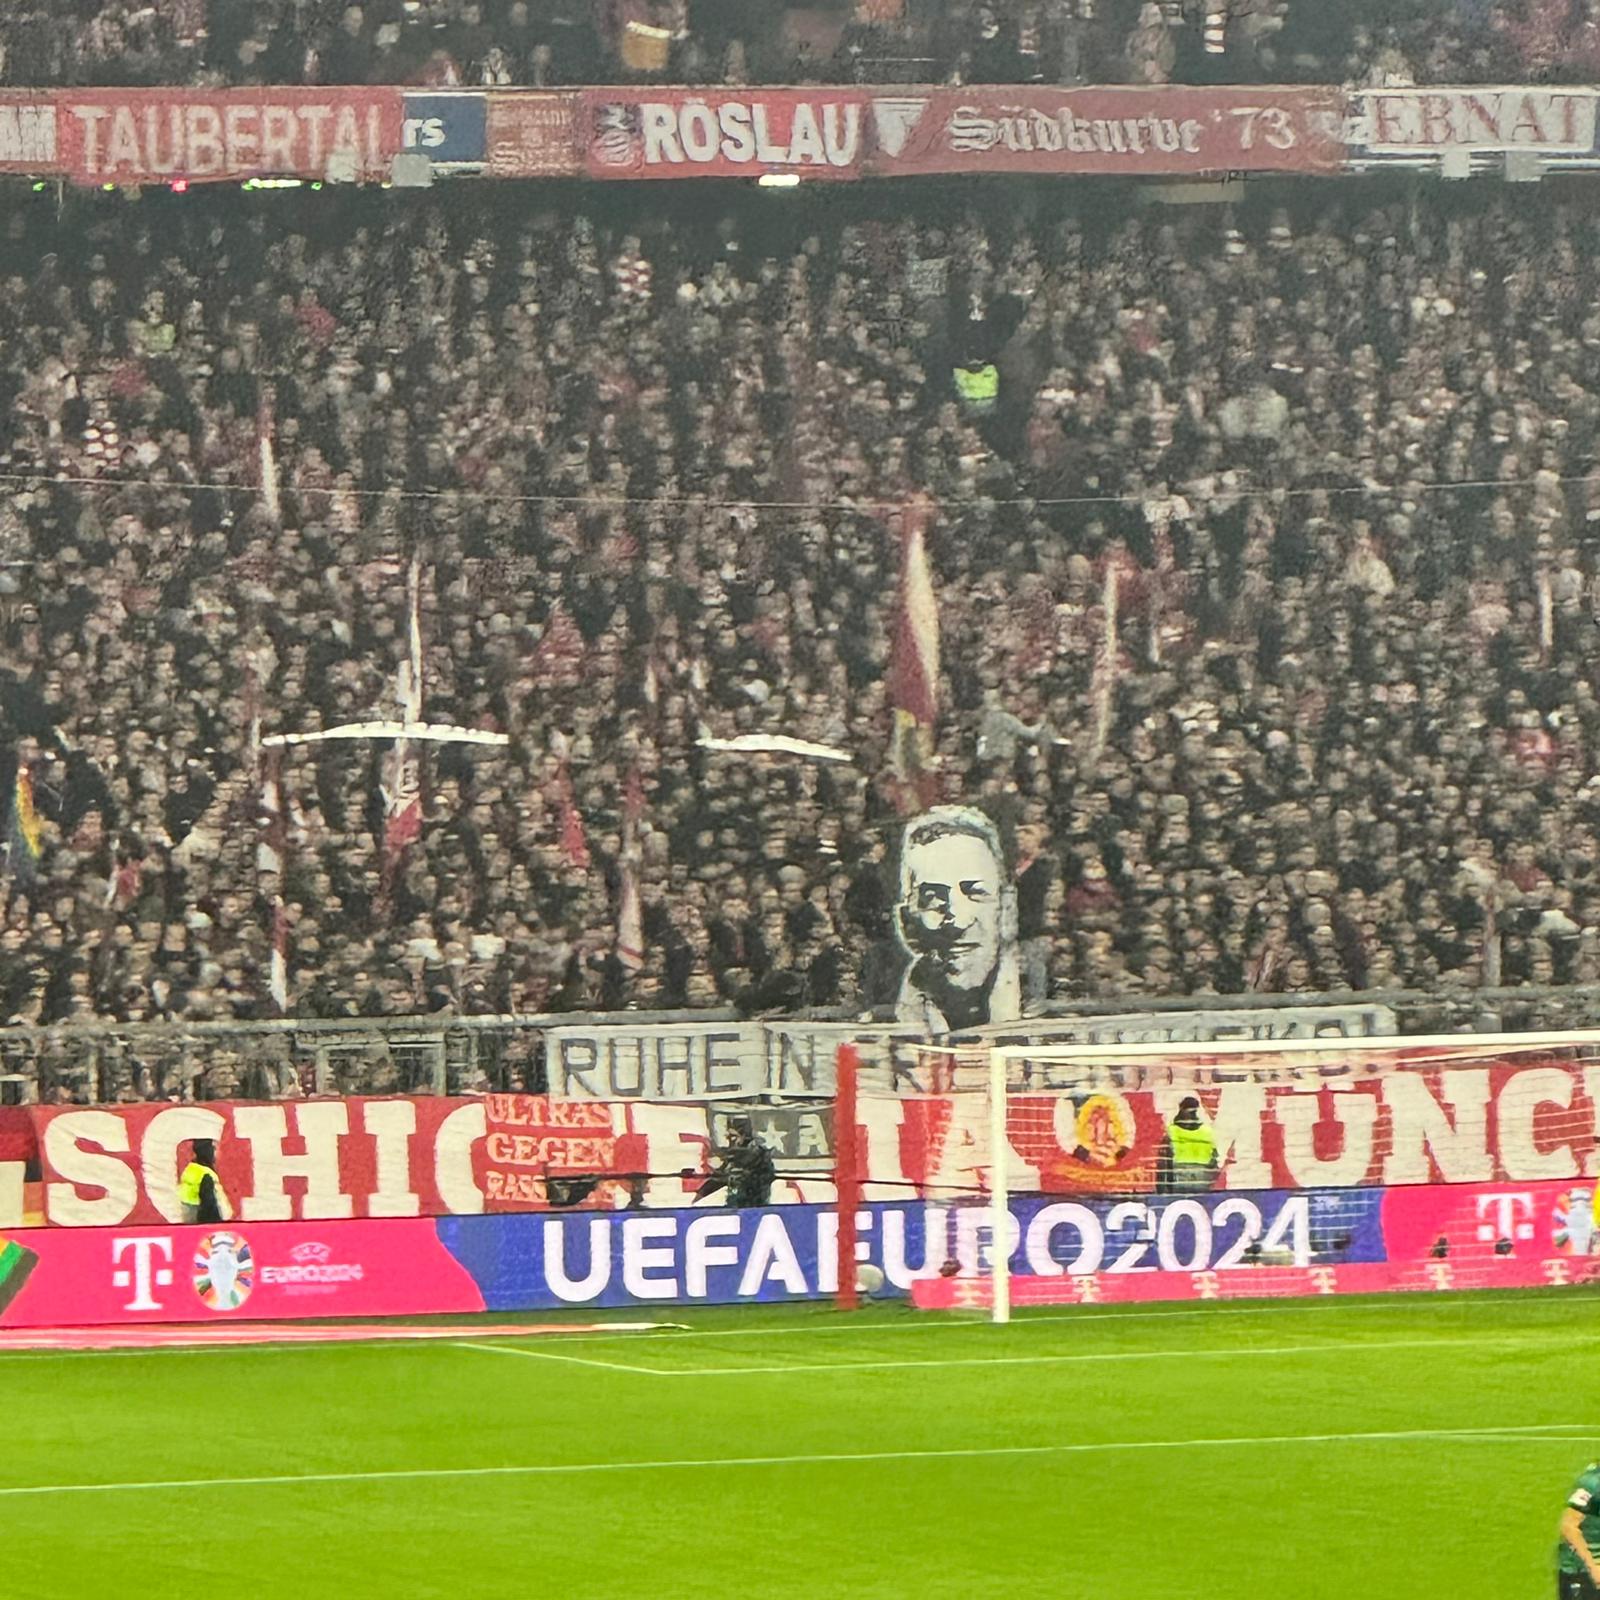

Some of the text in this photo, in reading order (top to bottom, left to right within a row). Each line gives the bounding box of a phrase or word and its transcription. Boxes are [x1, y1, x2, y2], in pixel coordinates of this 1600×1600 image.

[642, 97, 841, 167] RÖSLAU
[560, 1032, 741, 1097] RUHE
[764, 1028, 815, 1092] IN
[484, 1094, 613, 1128] ULTRAS
[486, 1133, 616, 1169] GEGEN
[542, 1196, 1317, 1302] UEFA EURO 2024
